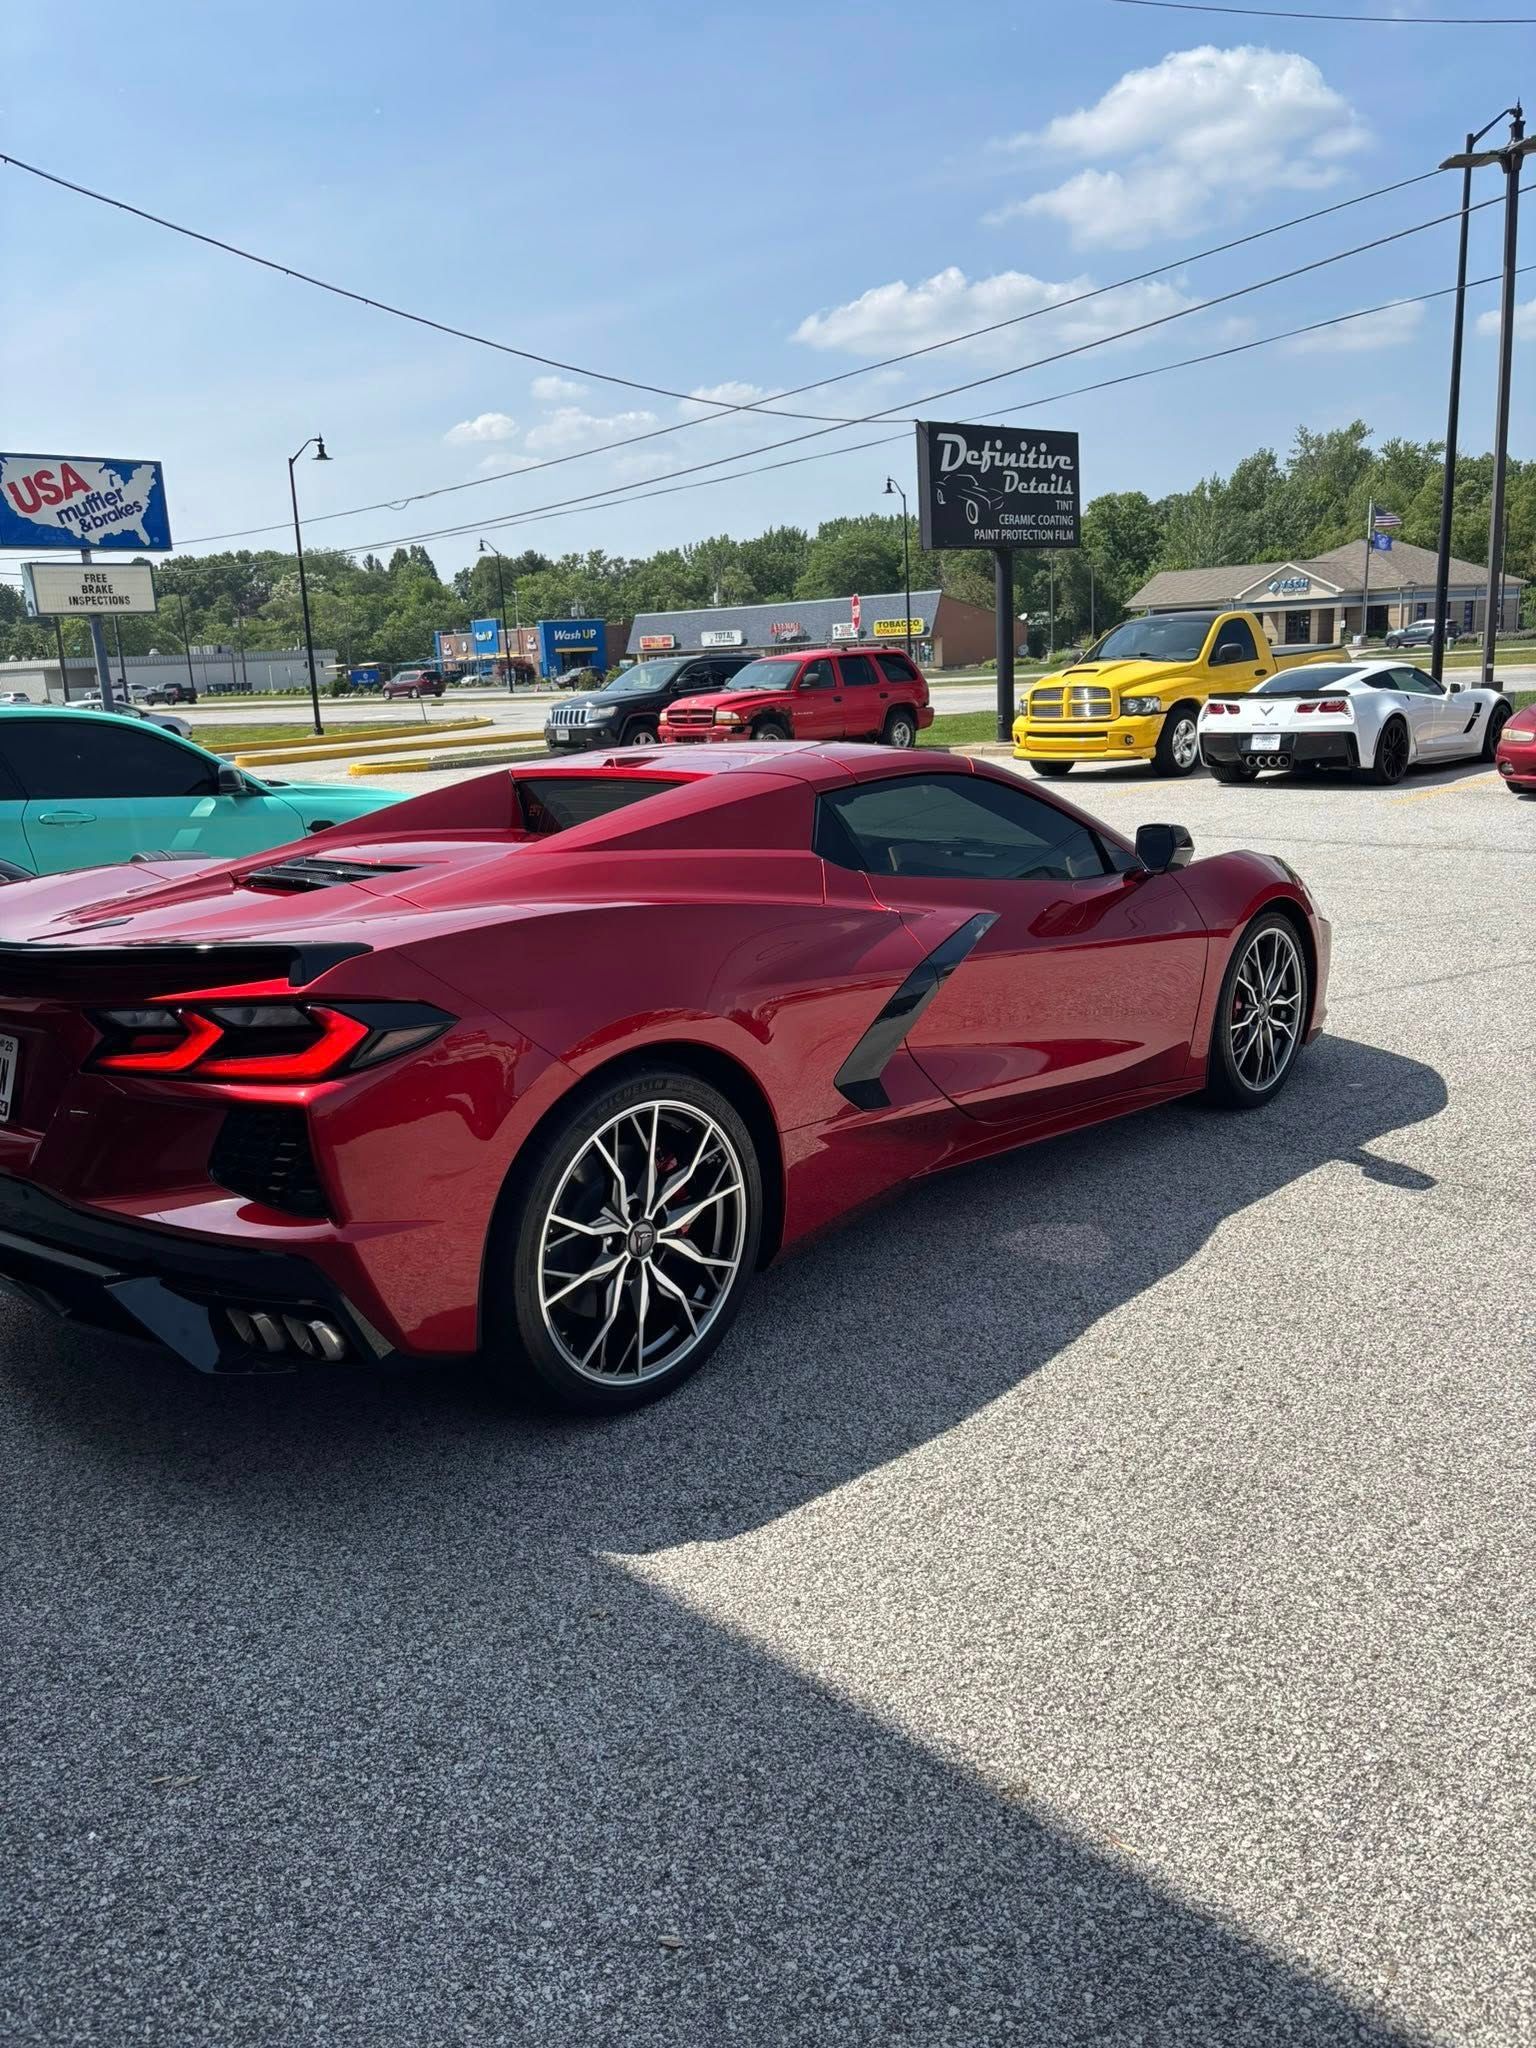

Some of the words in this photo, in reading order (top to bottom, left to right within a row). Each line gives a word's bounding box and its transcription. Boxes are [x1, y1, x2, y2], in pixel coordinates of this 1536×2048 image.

[936, 432, 1074, 474] Definitive
[7, 462, 92, 513] USA
[1002, 470, 1074, 495] Details
[56, 487, 125, 525] muffler
[1055, 500, 1074, 511] TINT
[998, 514, 1036, 525] CERAMIC
[1037, 514, 1074, 526] COATING
[974, 528, 1000, 540] PAINT
[1001, 529, 1054, 540] PROTECTION
[1055, 529, 1074, 540] FILM
[83, 573, 107, 583] FREE
[81, 584, 114, 594] BRAKE
[68, 595, 131, 606] INSPECTIONS
[553, 630, 581, 641] Wash
[582, 629, 597, 640] UP
[714, 631, 735, 640] TOTAL
